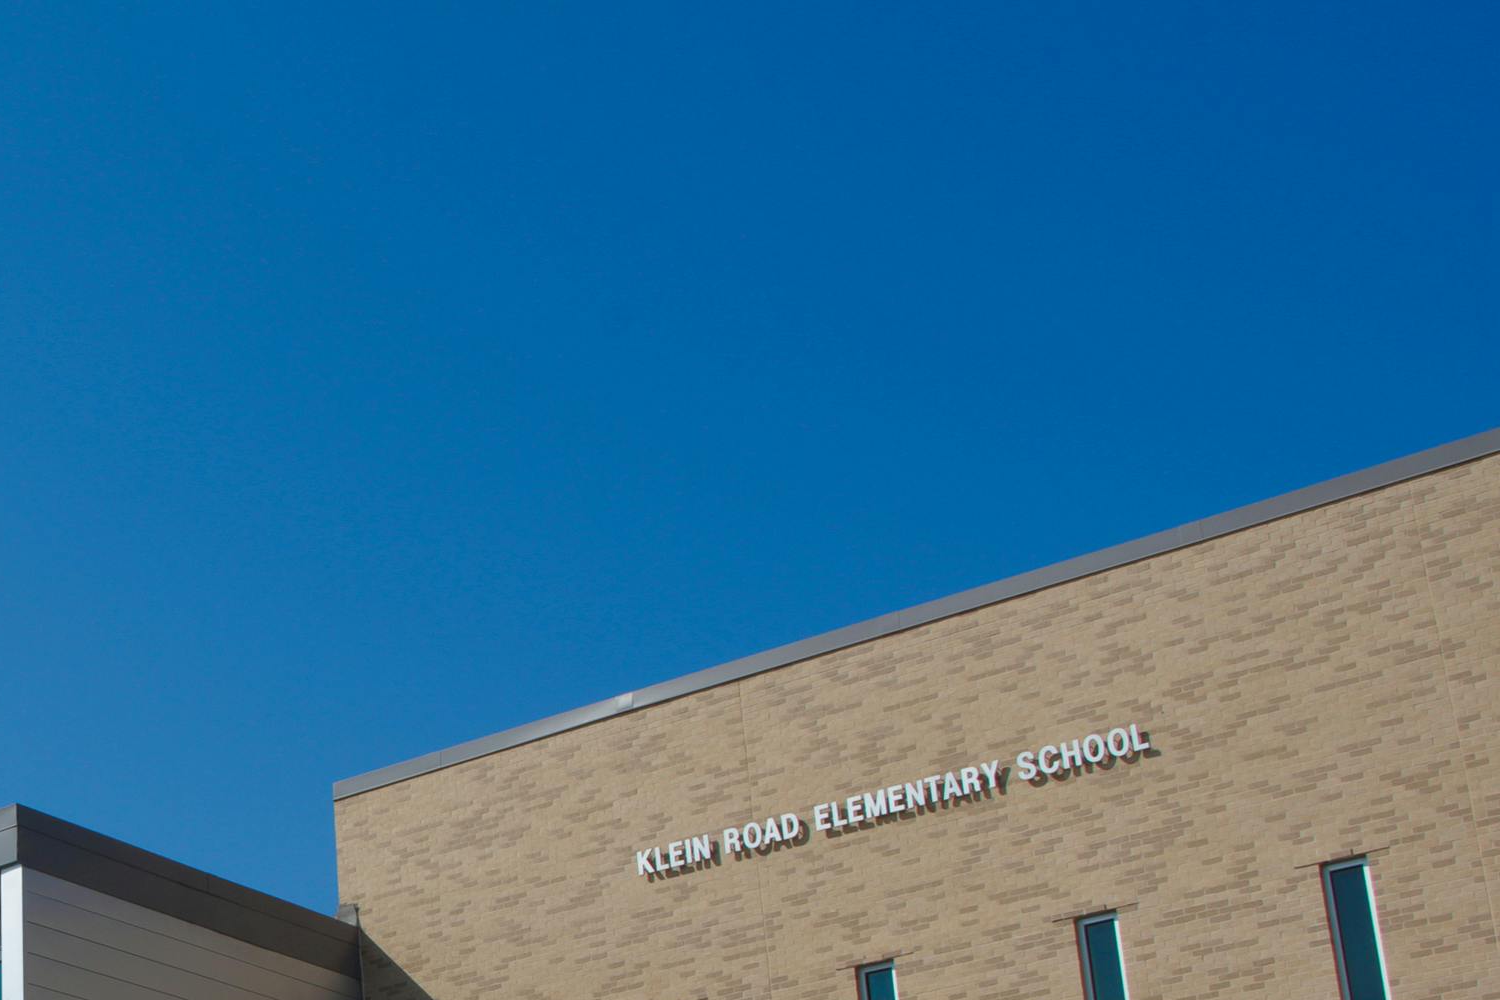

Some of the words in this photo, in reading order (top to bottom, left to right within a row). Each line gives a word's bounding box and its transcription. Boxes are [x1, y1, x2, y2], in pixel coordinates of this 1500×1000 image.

[636, 833, 711, 877] KLEIN
[723, 812, 800, 855] ROAD
[813, 759, 1000, 832] ELEMENTARY
[1016, 723, 1150, 782] SCHOOL
